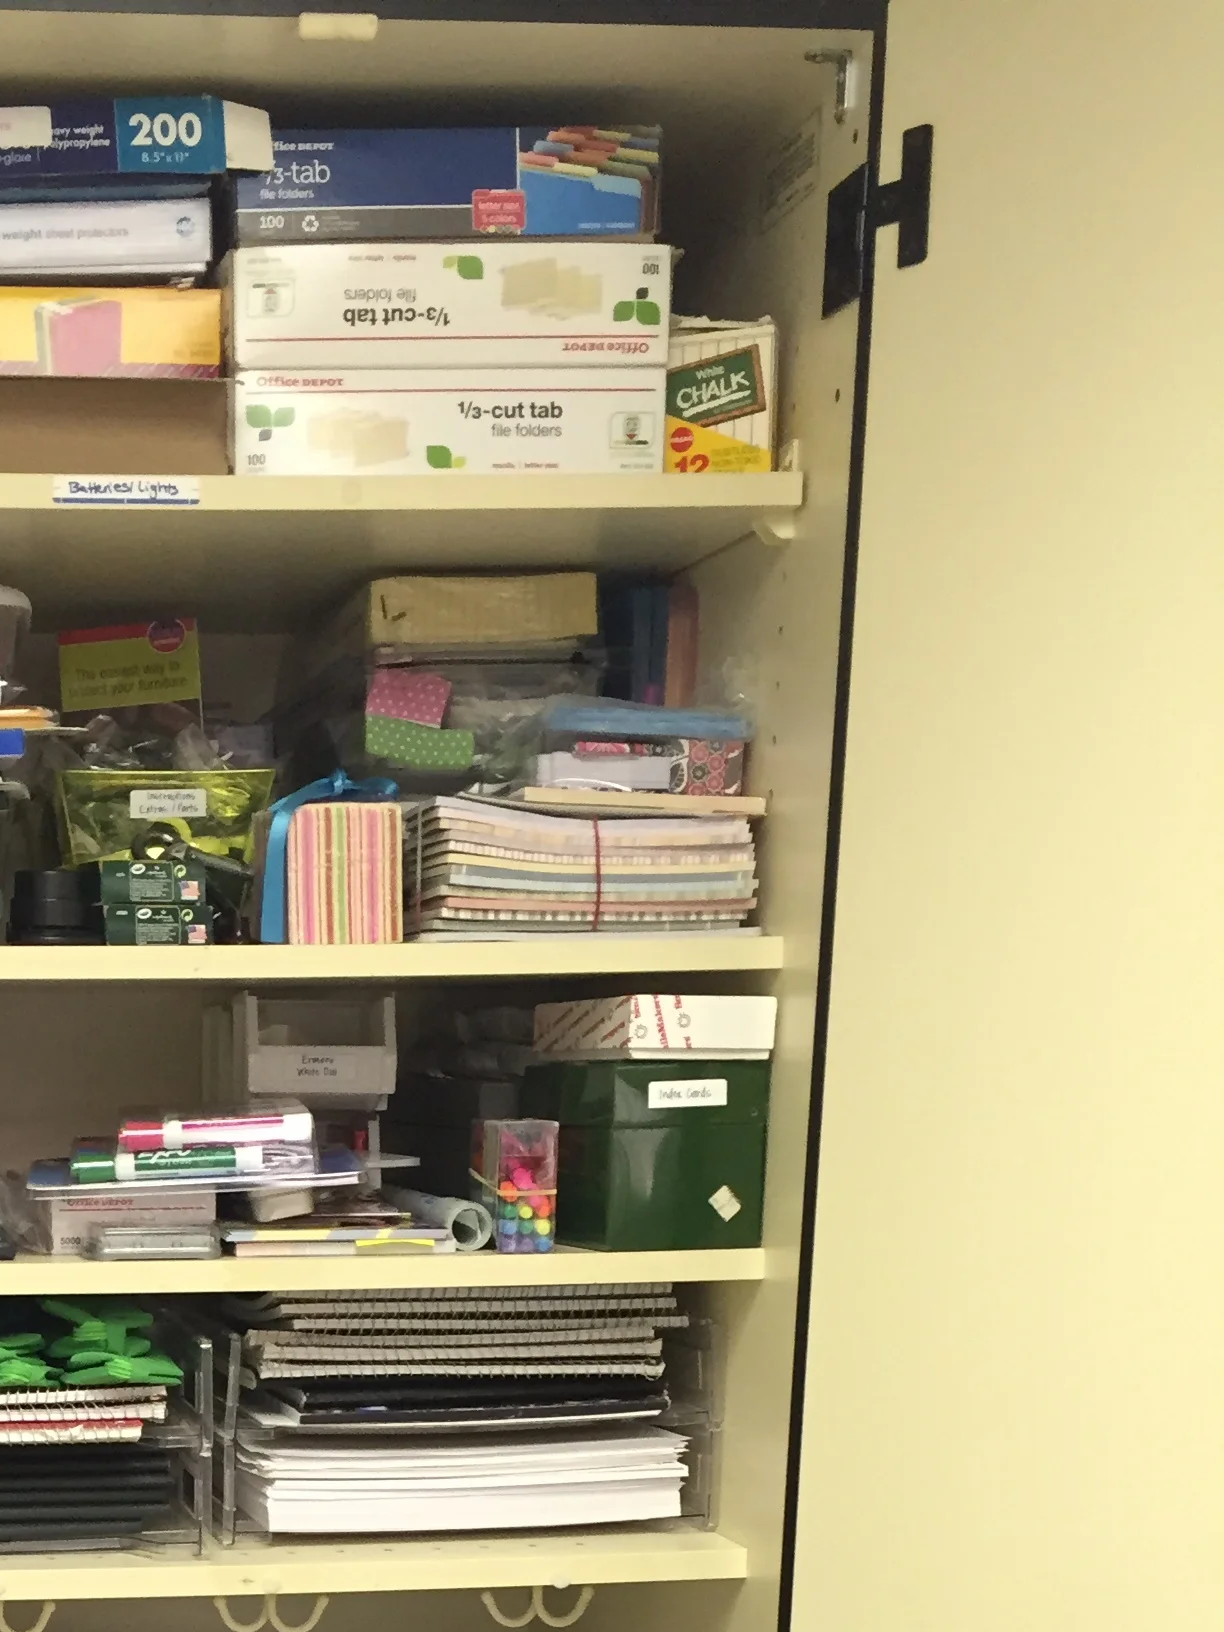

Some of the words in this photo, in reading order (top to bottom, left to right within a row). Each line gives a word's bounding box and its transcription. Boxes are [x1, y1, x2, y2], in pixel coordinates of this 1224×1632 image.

[73, 124, 104, 138] weight
[128, 111, 202, 147] 200
[259, 215, 285, 229] 100
[1, 228, 42, 242] weight
[343, 288, 393, 302] folders
[396, 289, 417, 302] file
[342, 306, 377, 327] tab
[562, 341, 607, 352] DEPOT
[609, 342, 649, 354] Office
[695, 365, 725, 380] White
[255, 376, 300, 388] Office
[301, 377, 344, 387] DEPOT
[676, 370, 751, 409] CHALK
[530, 400, 563, 420] tab
[490, 423, 513, 437] file
[515, 423, 563, 438] folders
[246, 453, 267, 466] 100
[674, 453, 710, 474] 12
[138, 480, 180, 500] Lights
[658, 1087, 683, 1100] Index
[685, 1086, 712, 1098] Cards
